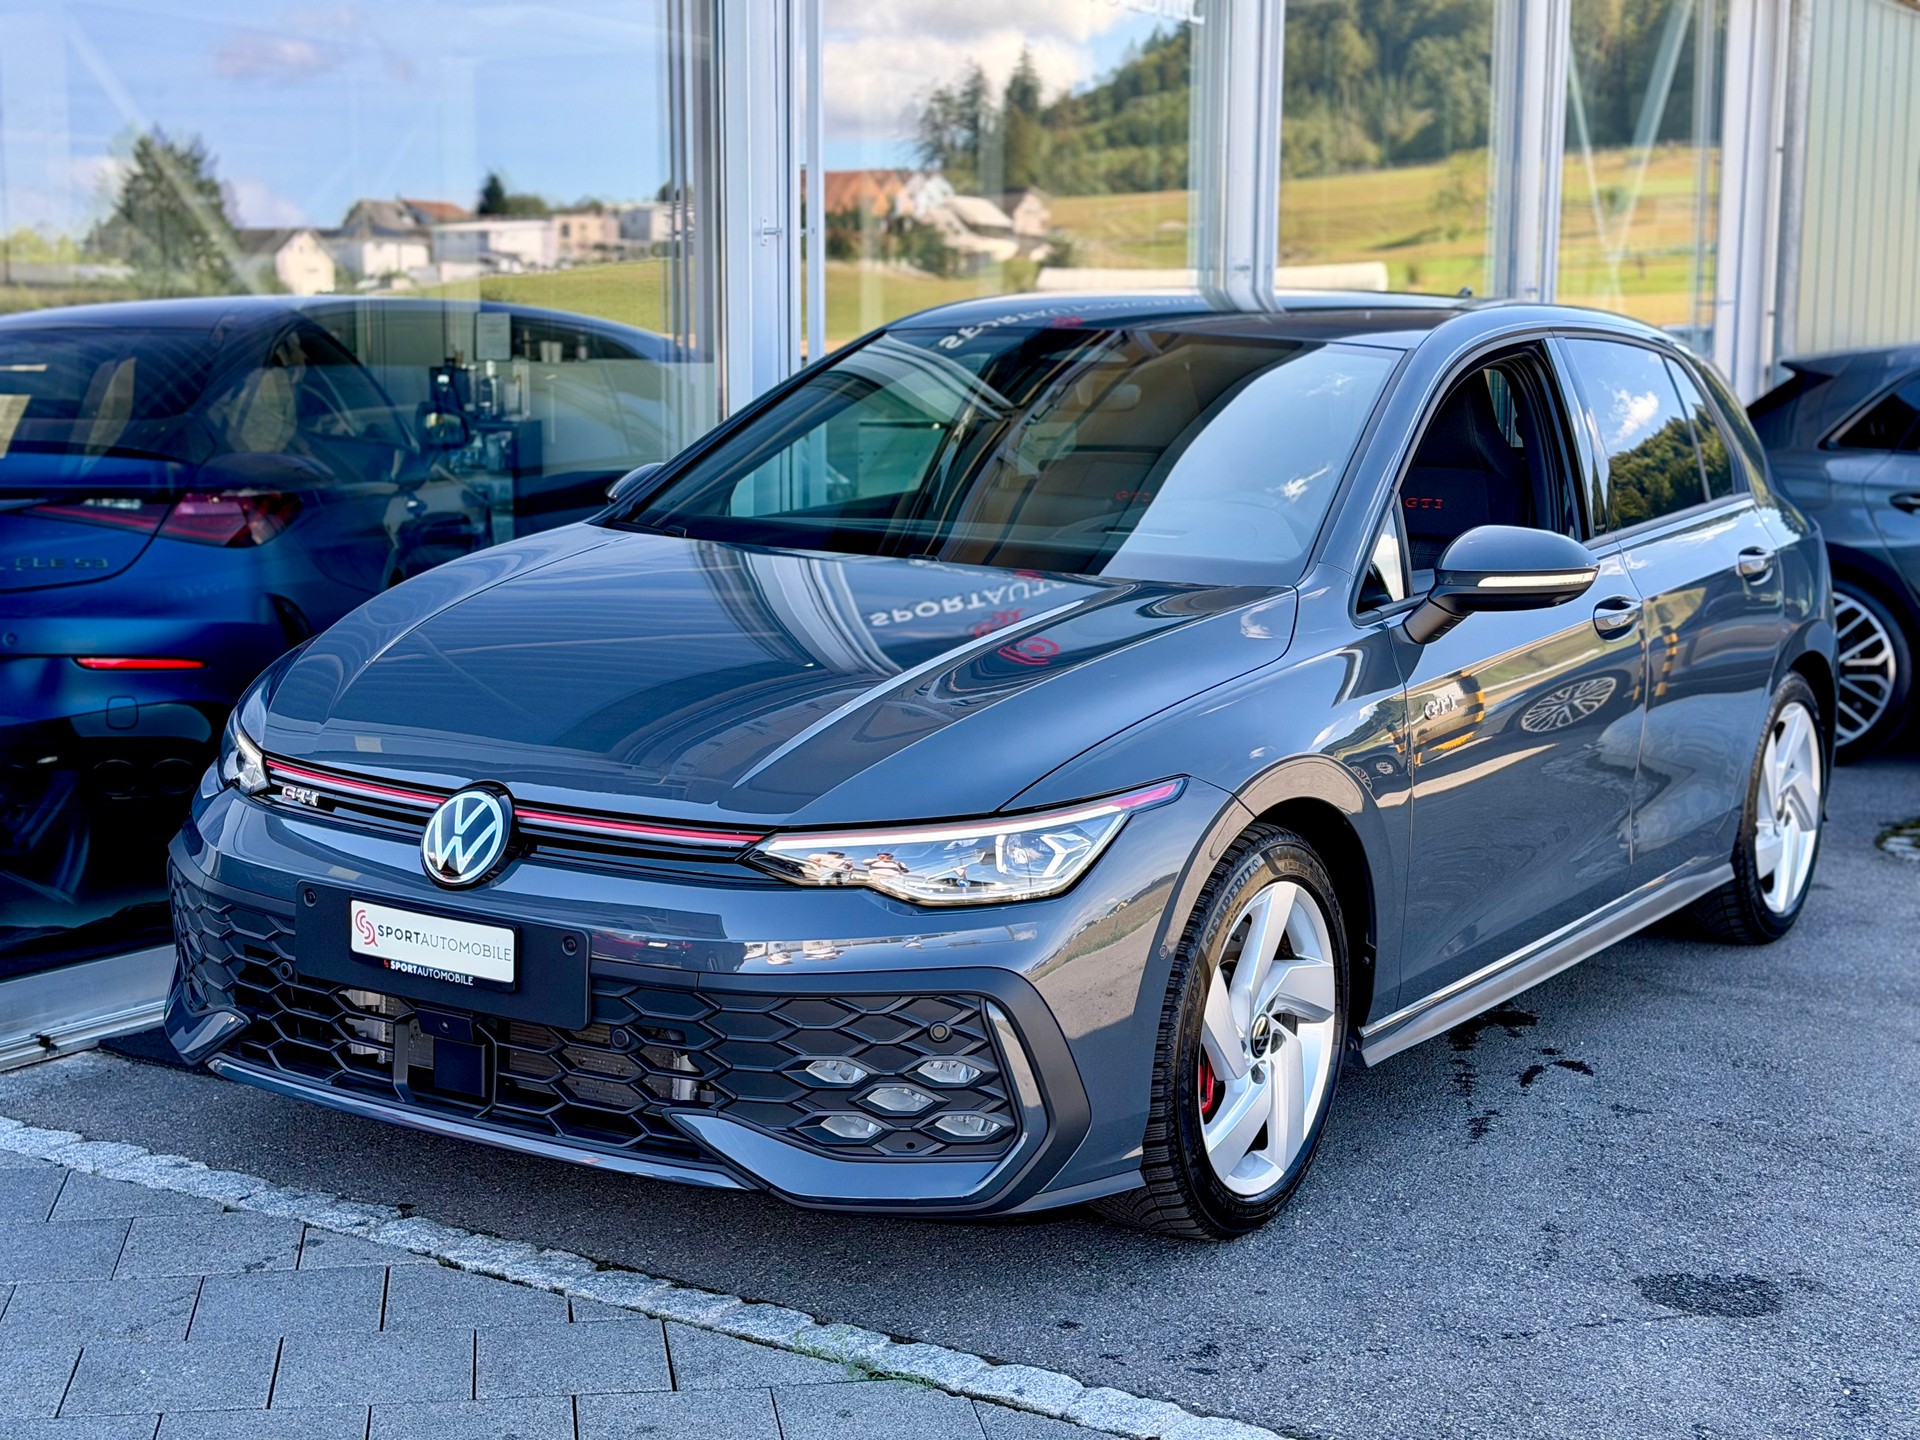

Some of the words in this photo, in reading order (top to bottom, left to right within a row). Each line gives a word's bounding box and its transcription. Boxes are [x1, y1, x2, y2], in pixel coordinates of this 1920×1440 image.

[1404, 497, 1443, 509] GTI
[1424, 693, 1458, 720] GTI
[281, 785, 320, 807] GTI
[424, 792, 503, 882] VW
[1205, 868, 1254, 945] SEMPERIT
[377, 924, 512, 962] SPORTAUTOMOBILE
[390, 960, 474, 986] SPORTAUTOMOBILE
